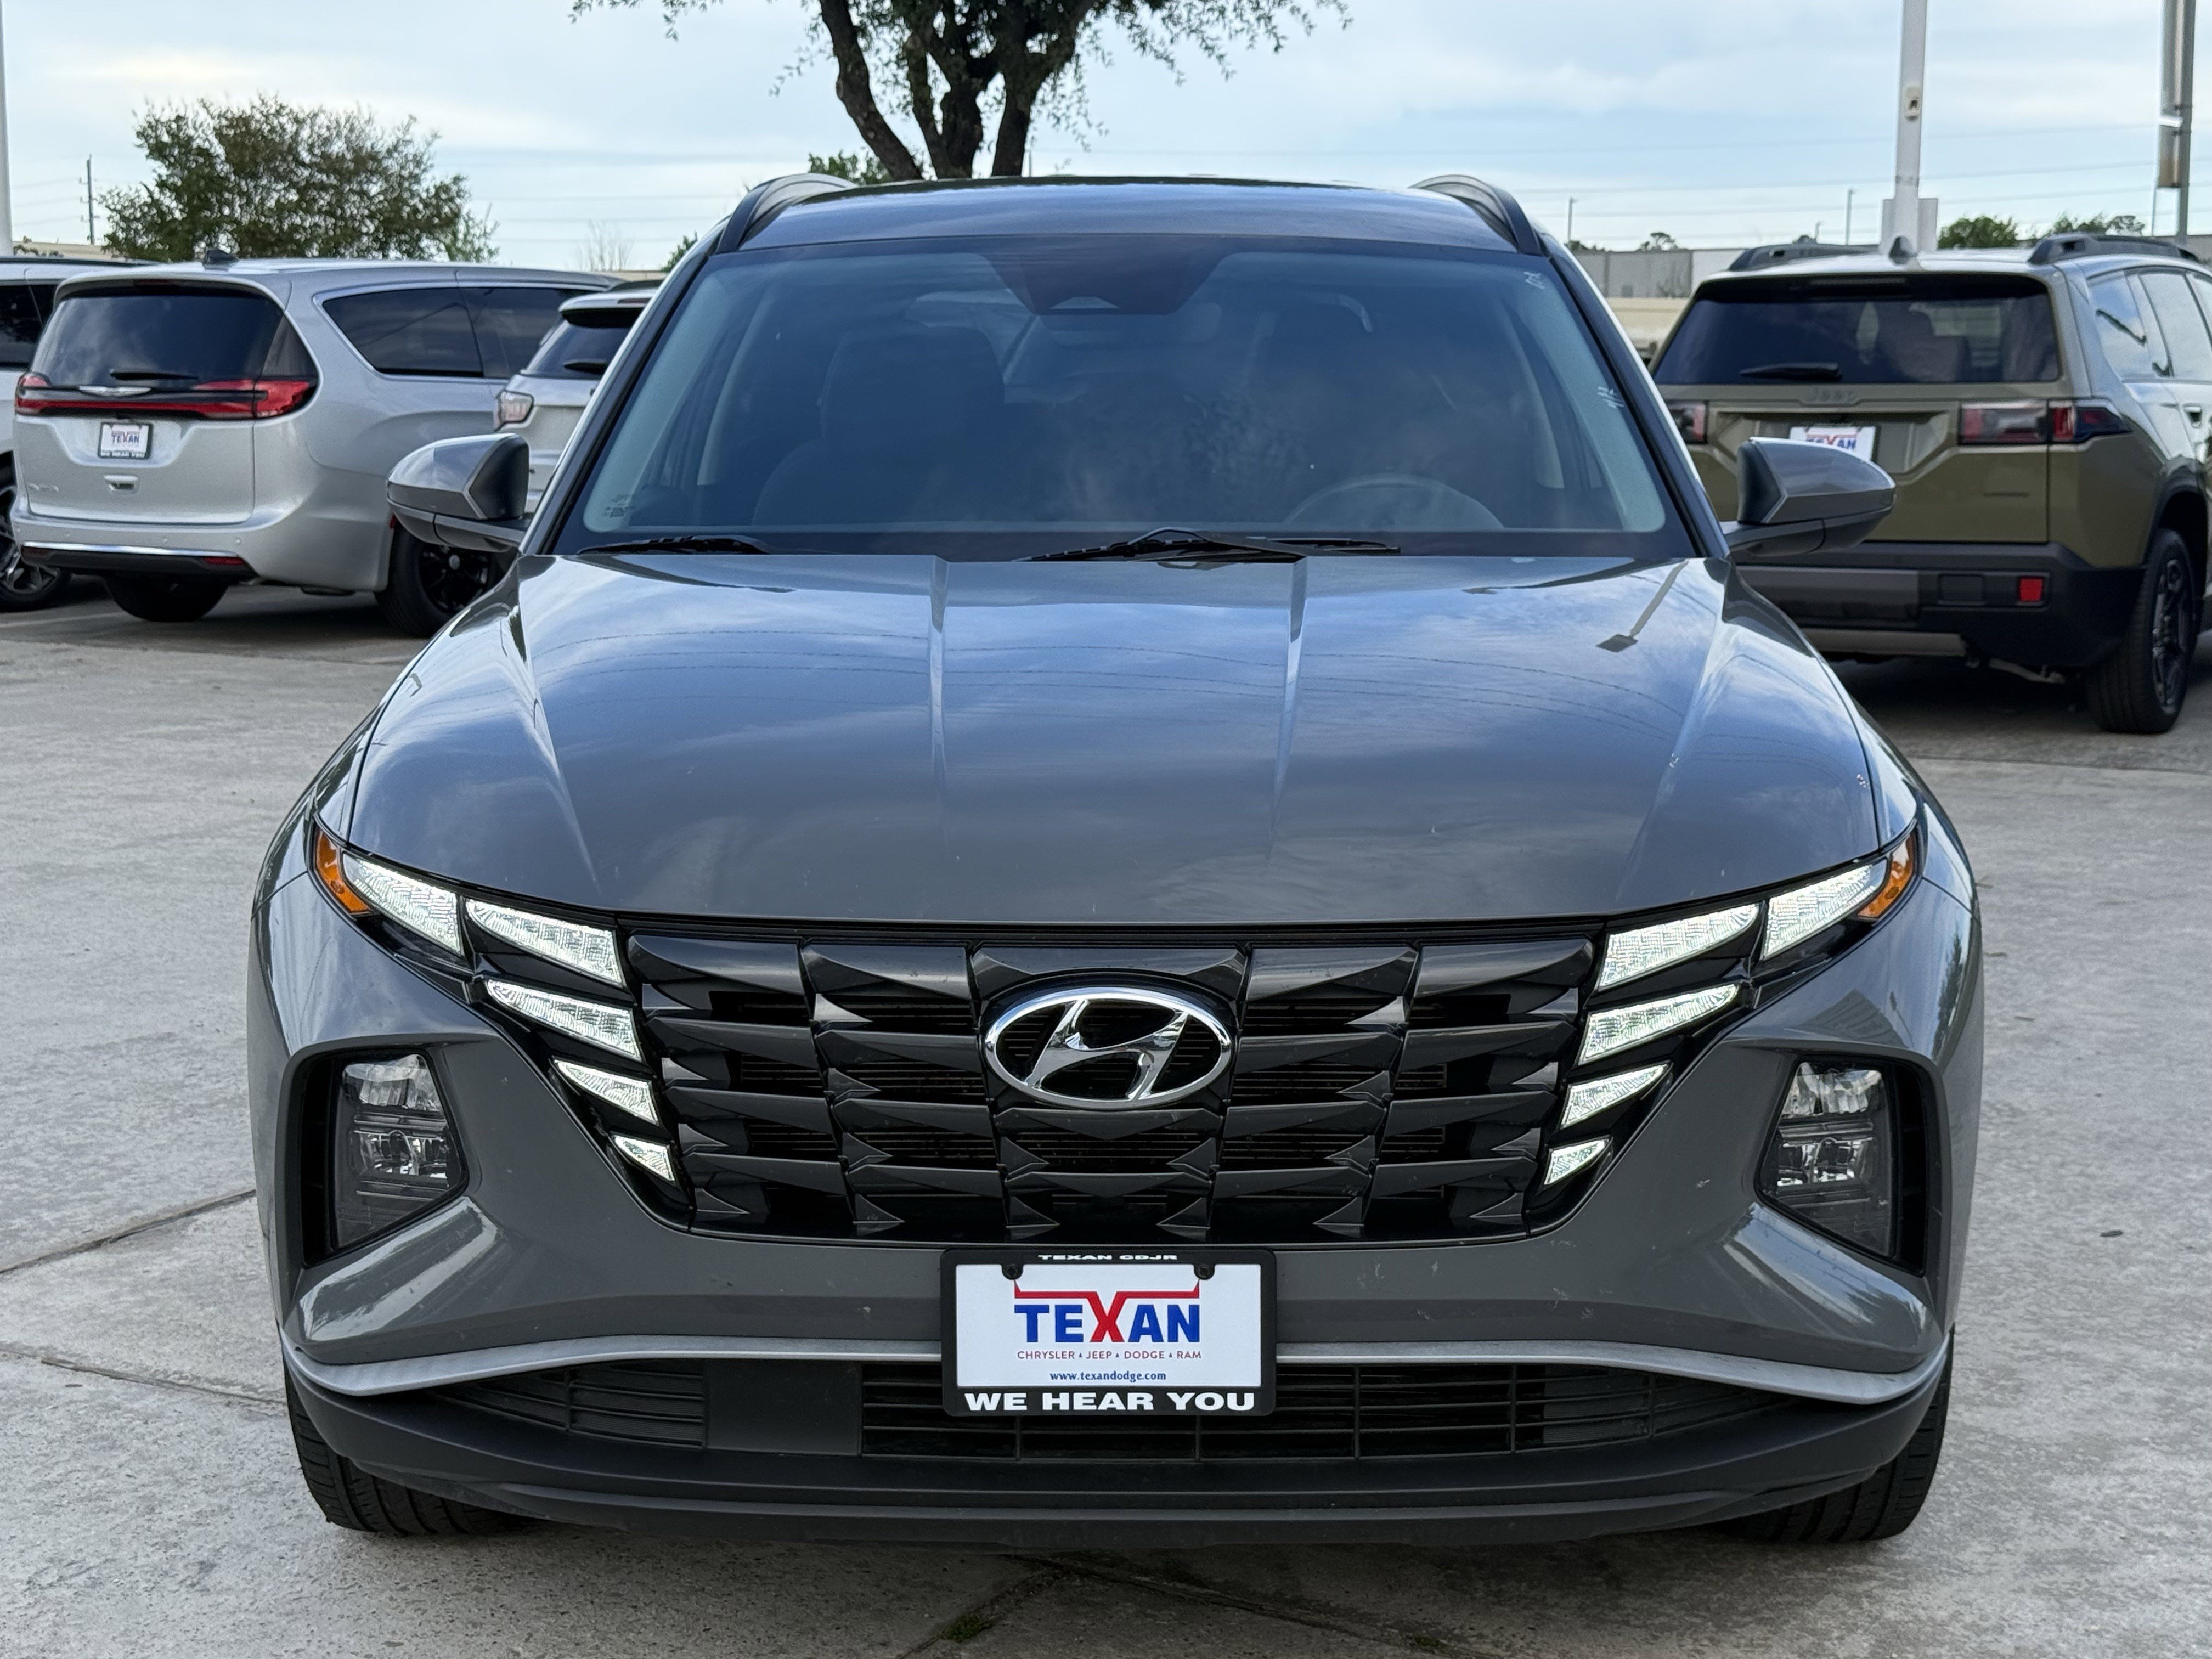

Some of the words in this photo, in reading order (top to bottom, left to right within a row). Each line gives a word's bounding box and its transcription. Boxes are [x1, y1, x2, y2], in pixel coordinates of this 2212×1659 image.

[111, 431, 140, 443] TEXAN
[1014, 1289, 1200, 1342] TEXAN
[1017, 1350, 1075, 1359] CHRYSLER
[1086, 1350, 1112, 1359] JEEP
[1124, 1350, 1165, 1359] DODGE
[1177, 1350, 1202, 1359] RAM
[1049, 1370, 1166, 1383] www.texandodge.com
[964, 1392, 1028, 1411] WE
[1042, 1392, 1154, 1411] HEAR
[1166, 1392, 1255, 1411] YOU
